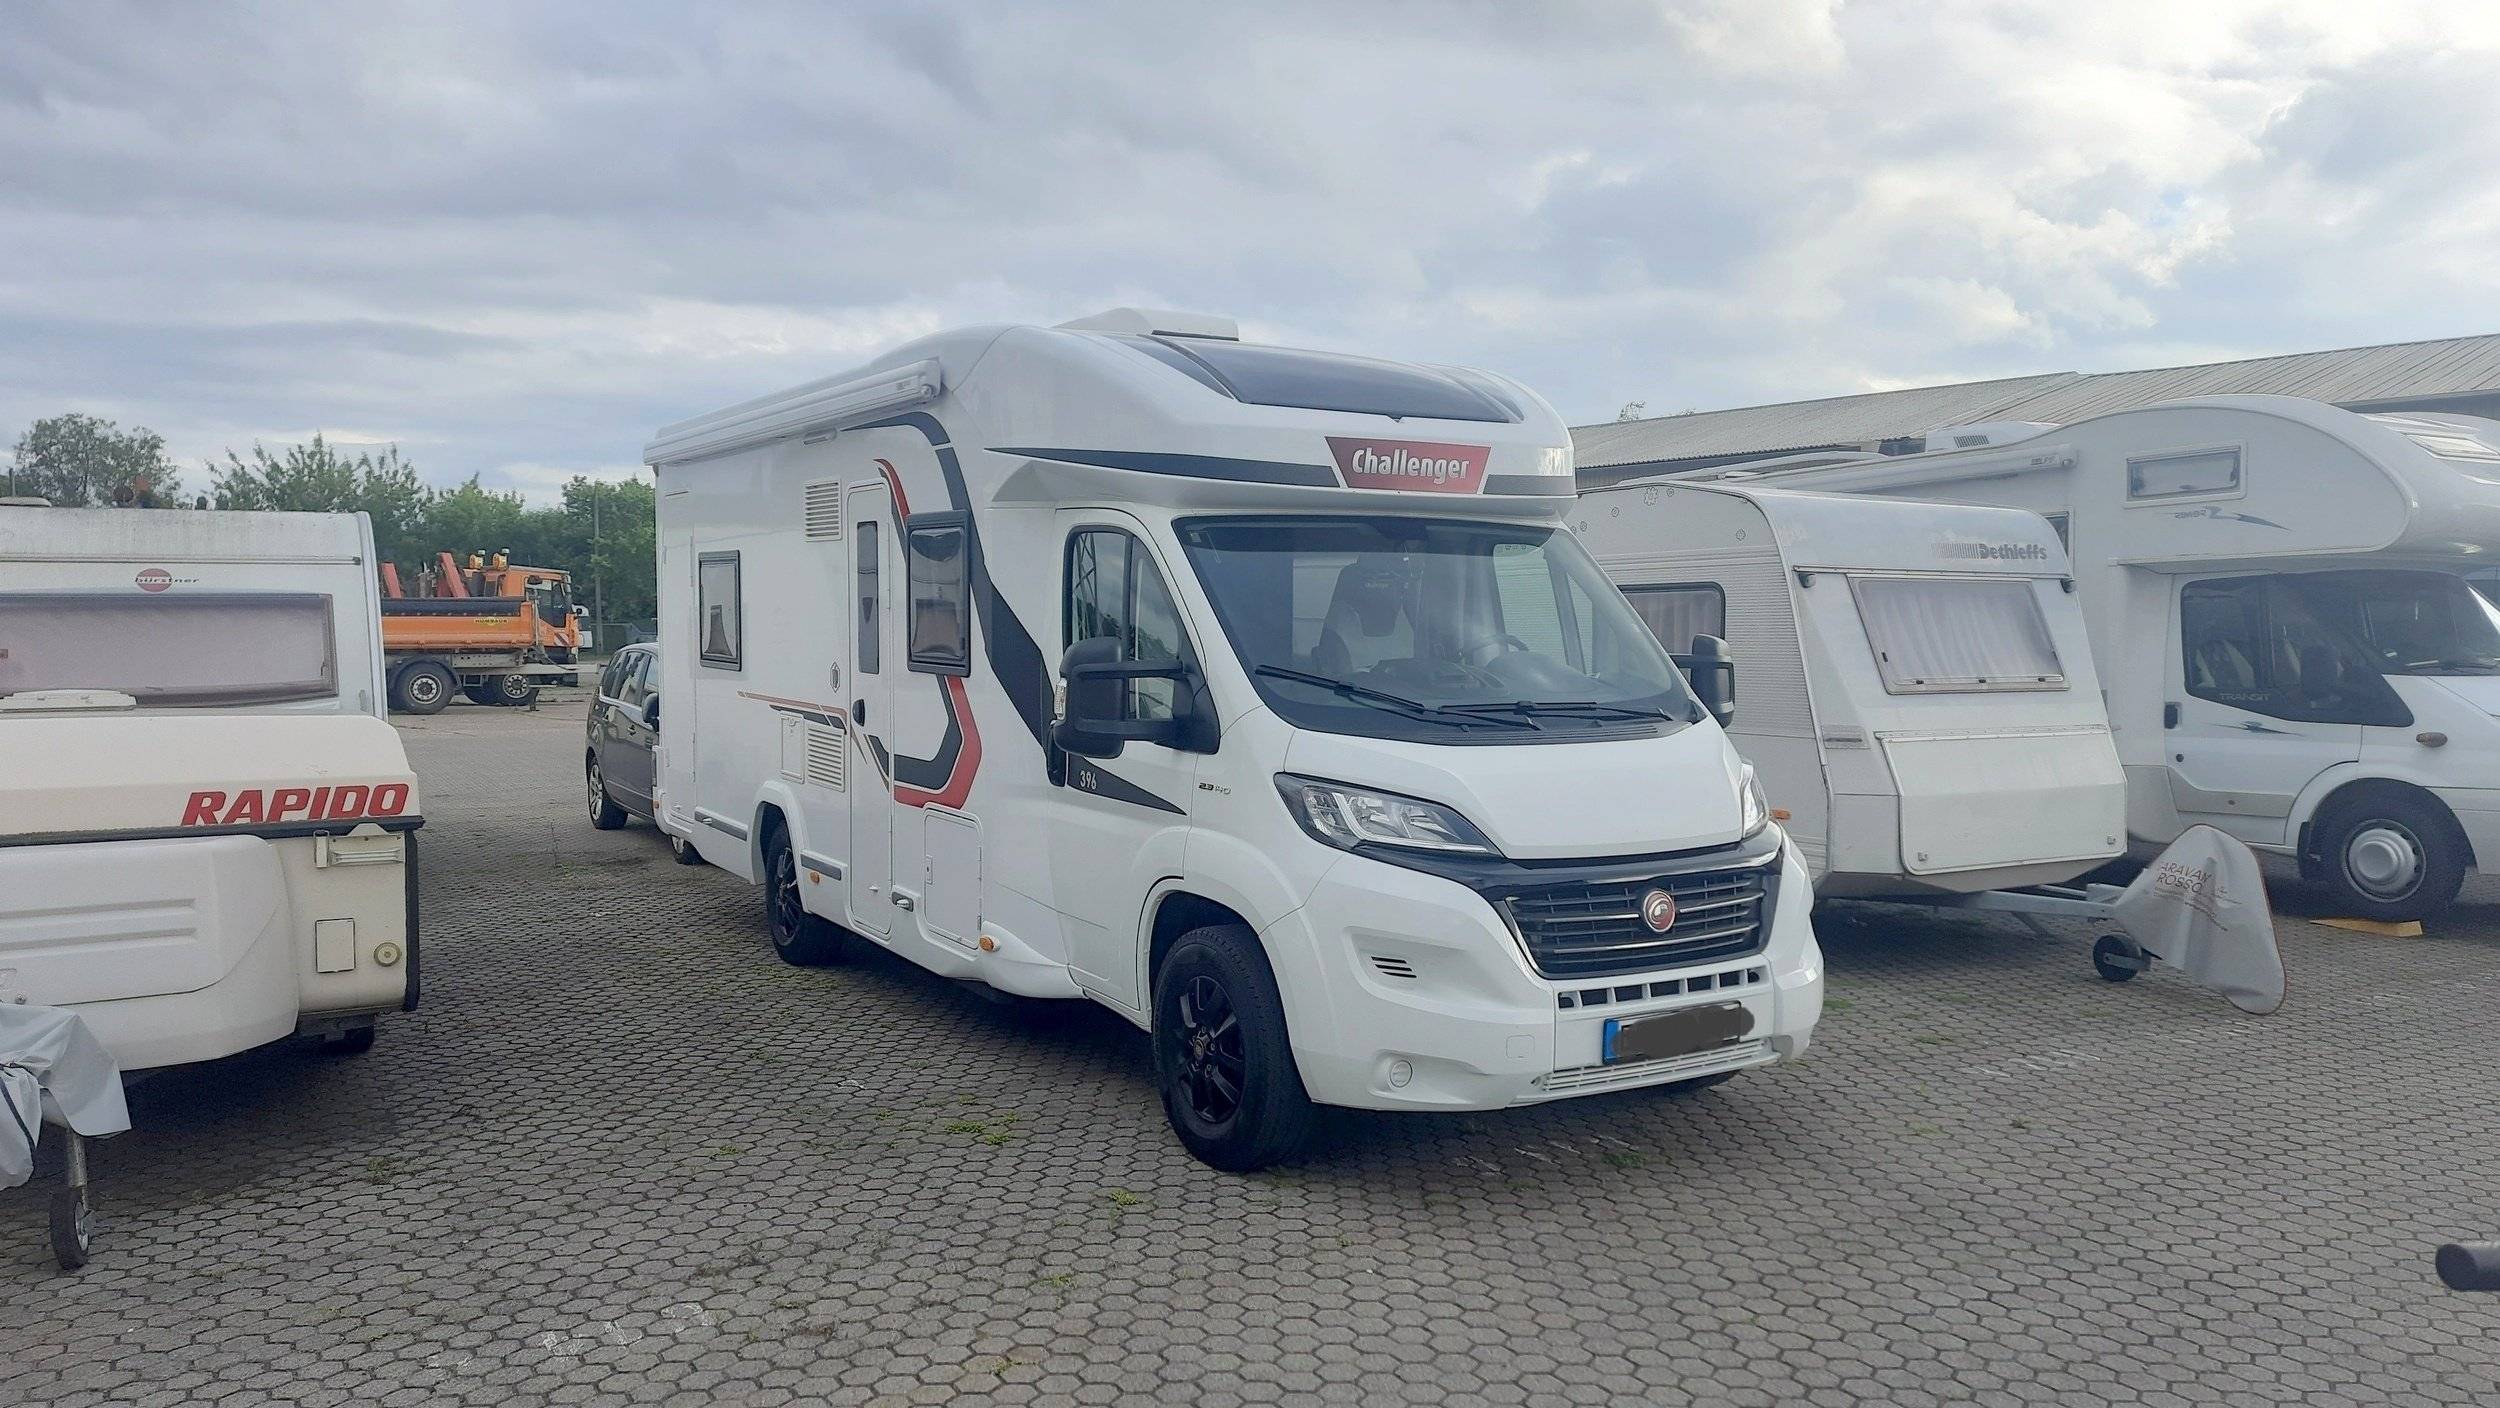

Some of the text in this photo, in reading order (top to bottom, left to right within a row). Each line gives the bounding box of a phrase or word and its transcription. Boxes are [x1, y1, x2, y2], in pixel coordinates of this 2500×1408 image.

[1352, 447, 1469, 485] Challenger
[1080, 770, 1097, 790] 396
[181, 783, 409, 826] RAPIDO
[2156, 873, 2203, 893] ROSSO
